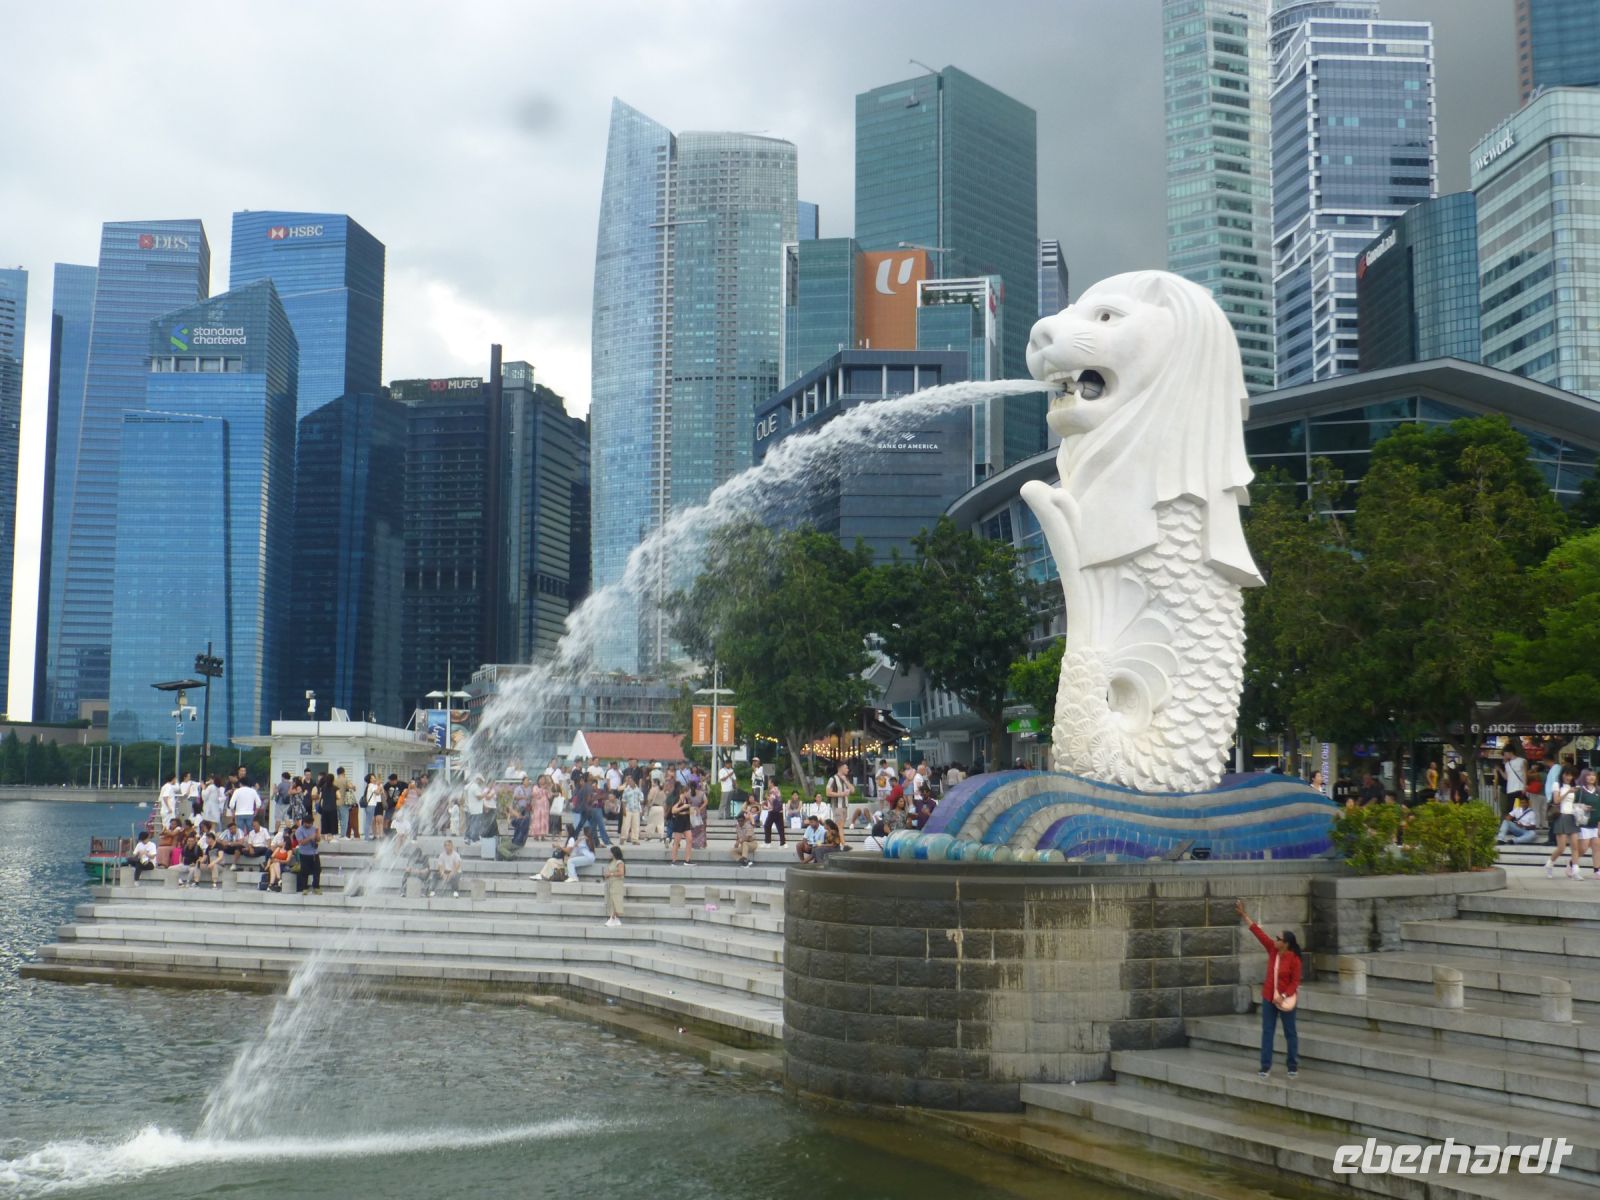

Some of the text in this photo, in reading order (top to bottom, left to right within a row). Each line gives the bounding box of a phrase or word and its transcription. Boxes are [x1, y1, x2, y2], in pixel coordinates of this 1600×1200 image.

[1475, 127, 1514, 169] wework
[289, 225, 324, 237] HSBC
[155, 235, 188, 249] DBS
[192, 326, 245, 336] standard
[192, 335, 247, 345] chartered
[448, 380, 478, 389] MUFG
[756, 413, 777, 441] OUE
[1488, 723, 1517, 734] DOG
